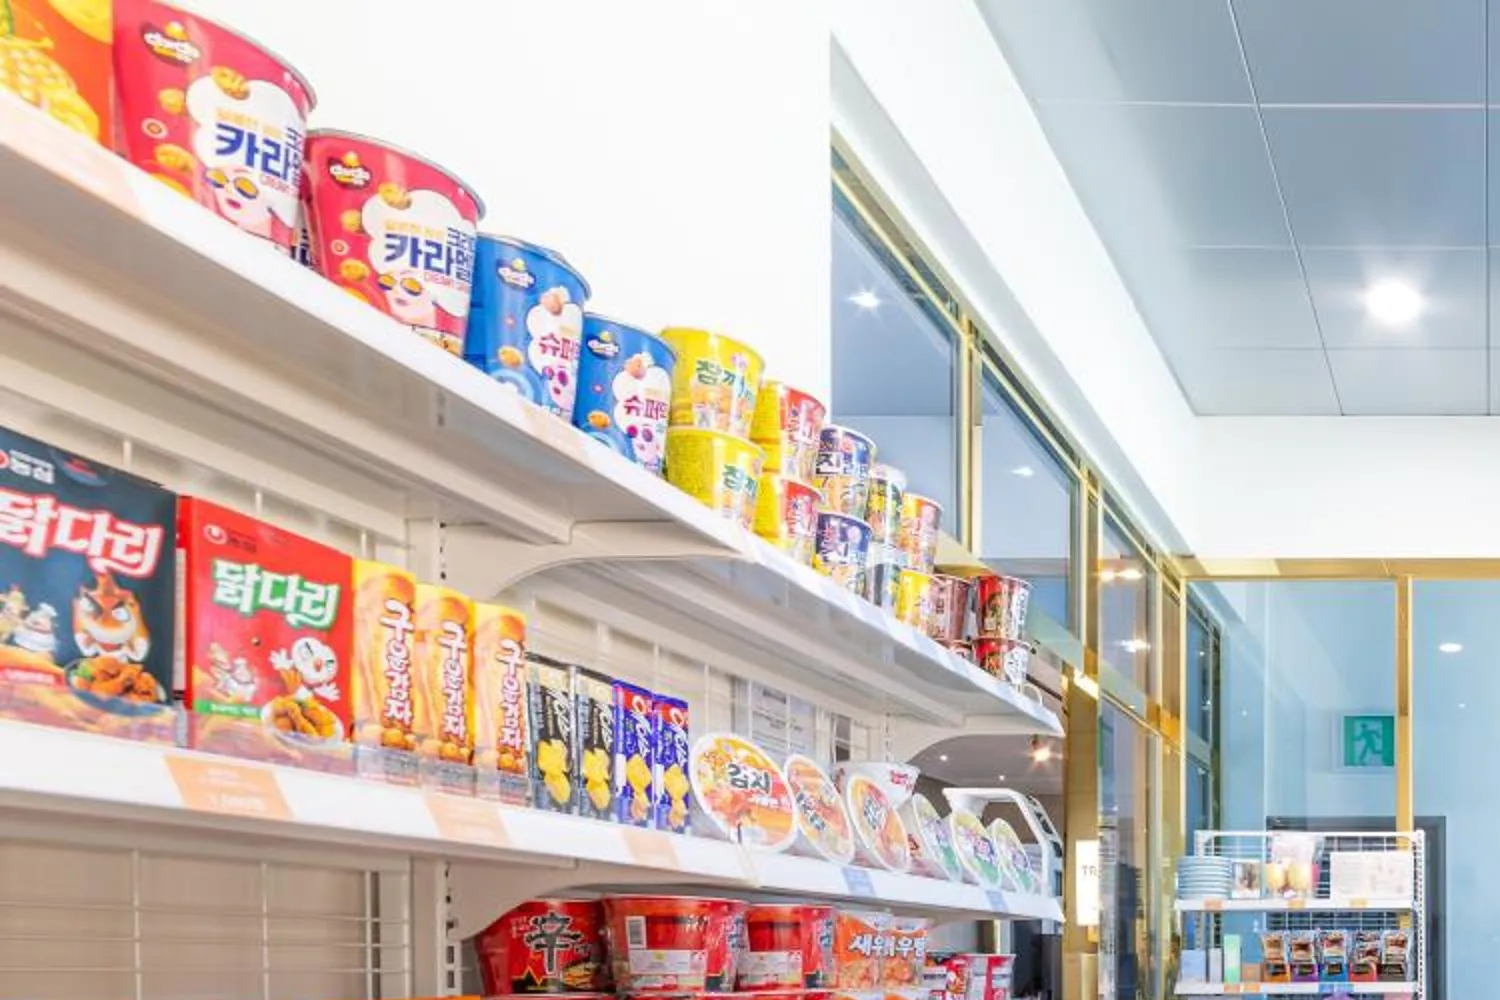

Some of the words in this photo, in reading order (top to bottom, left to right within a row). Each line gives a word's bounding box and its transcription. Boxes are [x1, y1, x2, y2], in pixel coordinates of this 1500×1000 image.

[0, 488, 163, 578] 닭다리
[212, 559, 340, 630] 닭다리
[524, 911, 584, 975] 辛
